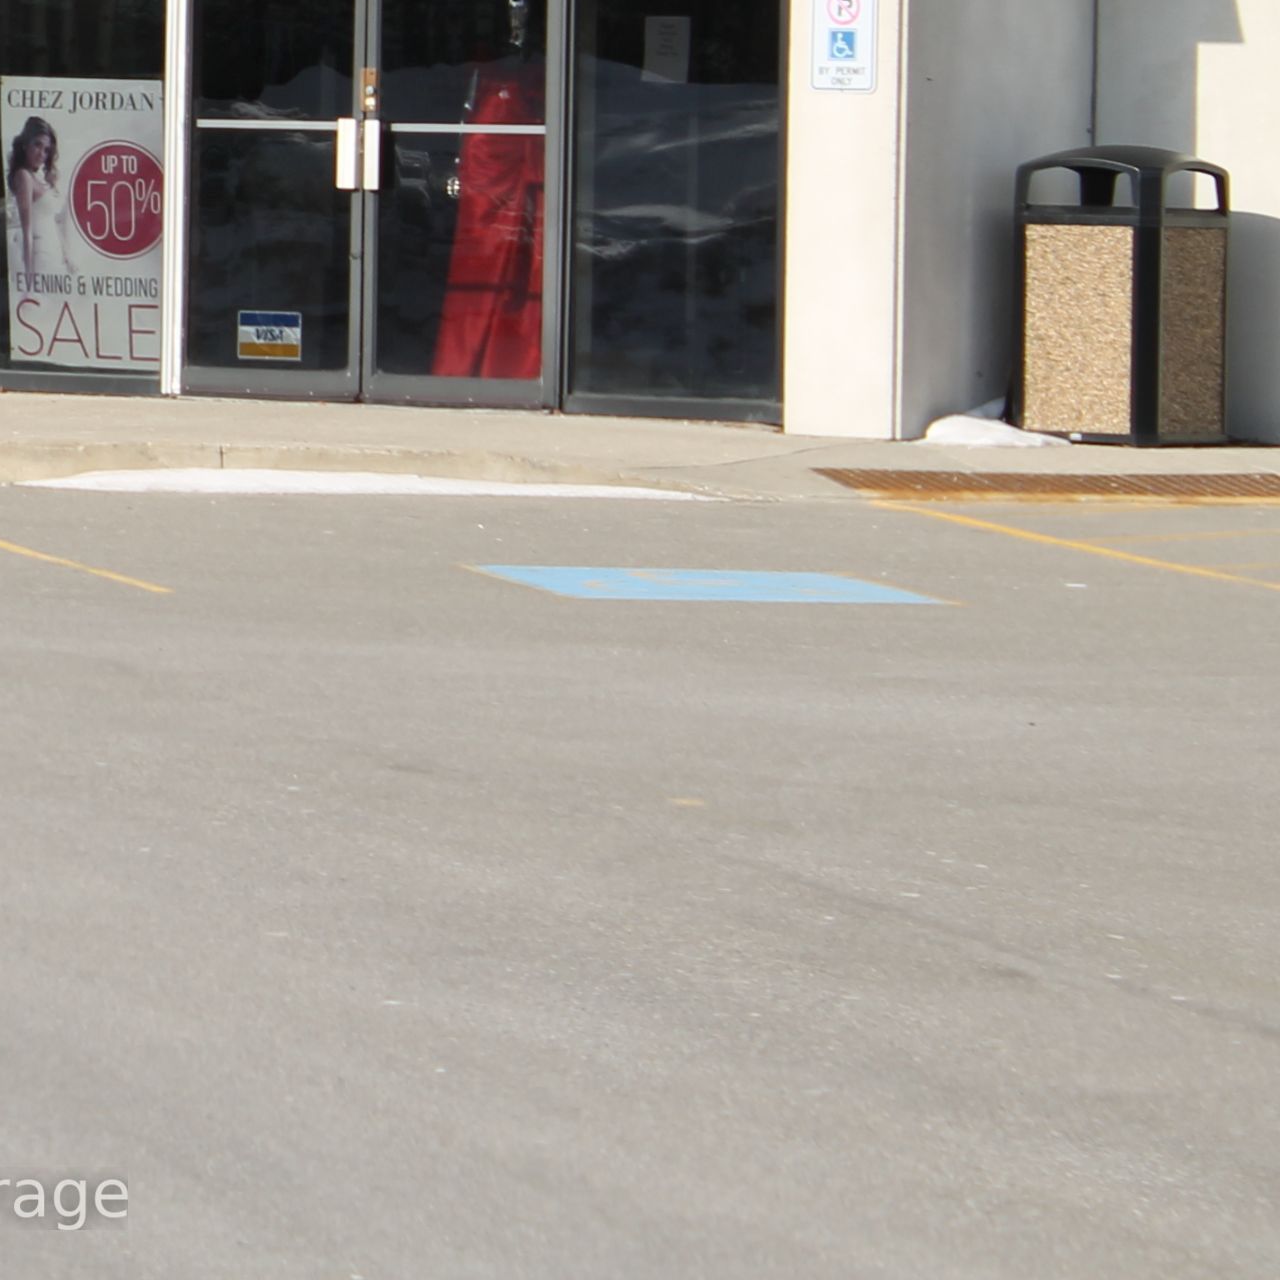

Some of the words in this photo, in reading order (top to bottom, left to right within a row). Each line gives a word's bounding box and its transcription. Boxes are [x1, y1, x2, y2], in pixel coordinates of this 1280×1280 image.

[7, 89, 63, 110] CHEZ
[68, 91, 154, 114] JORDAN
[101, 155, 118, 174] UP
[121, 156, 138, 174] TO
[87, 179, 161, 241] 50%
[16, 272, 72, 295] EVENING
[77, 276, 86, 295] &
[91, 276, 158, 298] WEDDING
[16, 298, 161, 362] SALE
[255, 327, 284, 341] VISA
